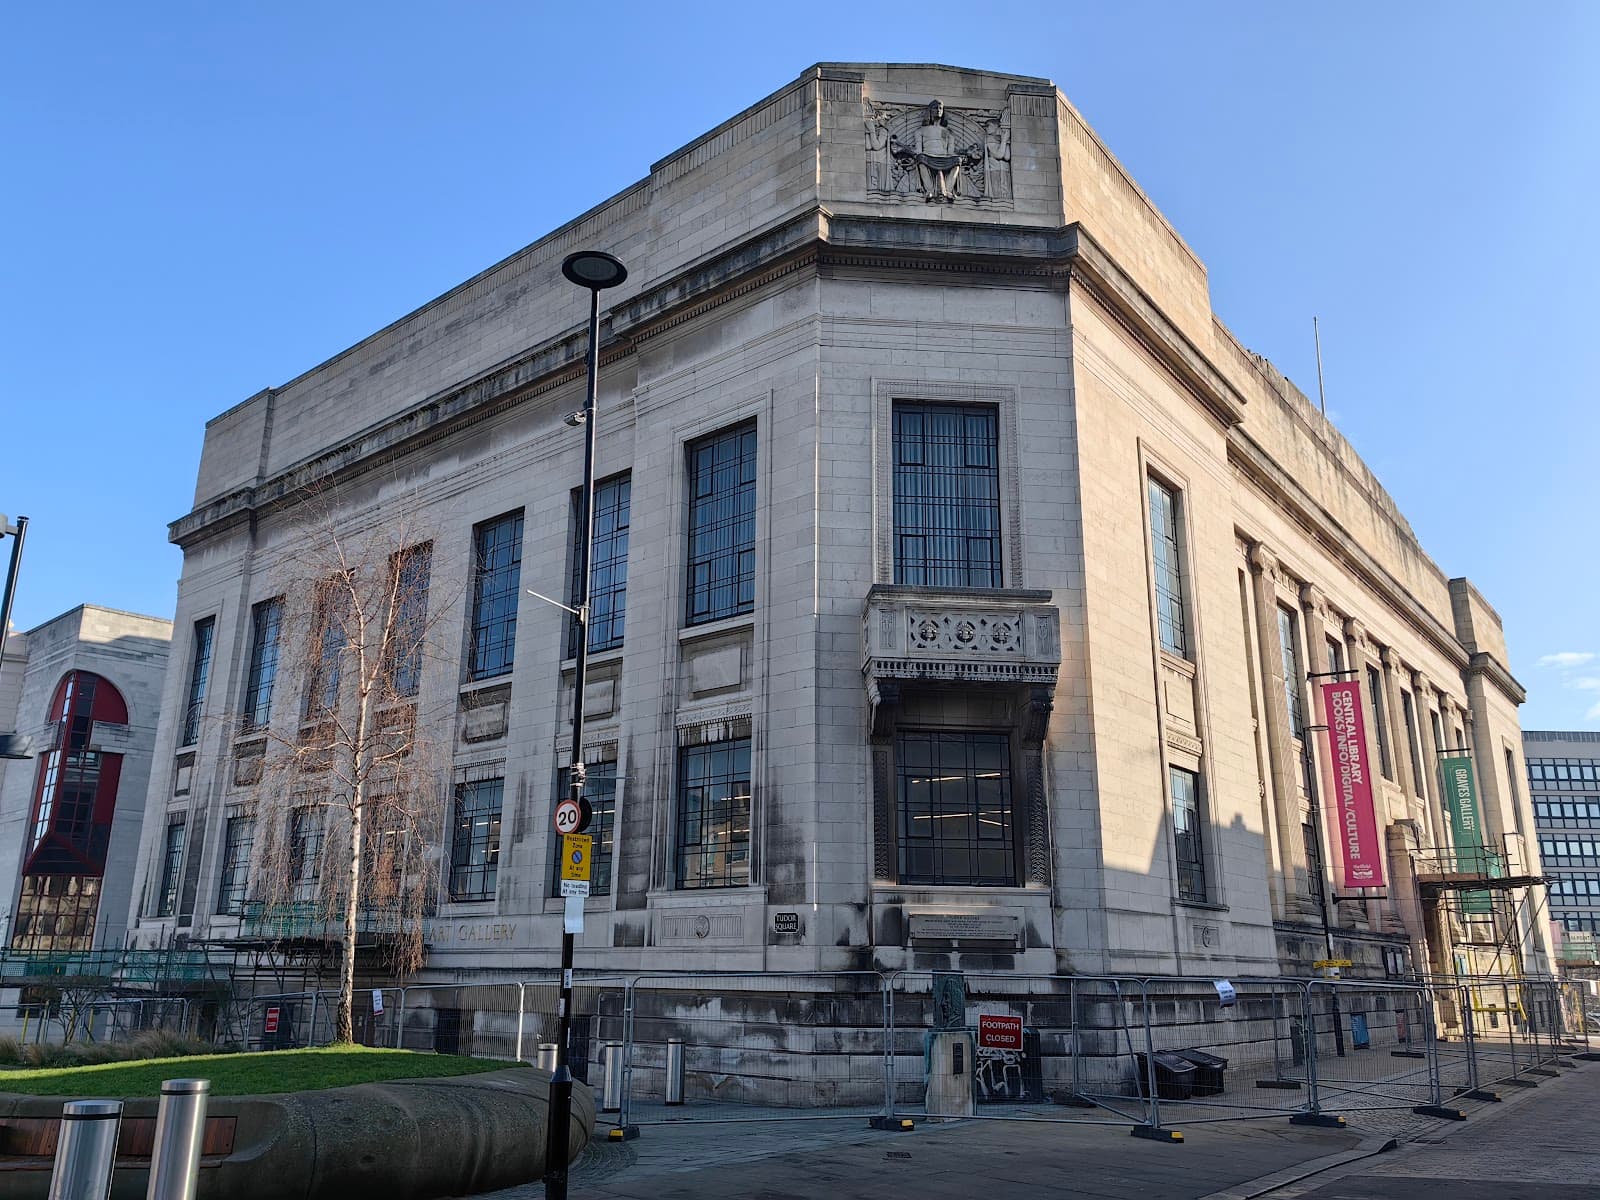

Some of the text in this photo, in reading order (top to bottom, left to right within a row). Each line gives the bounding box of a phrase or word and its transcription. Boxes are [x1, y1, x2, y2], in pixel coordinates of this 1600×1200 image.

[1342, 690, 1362, 785] CENTRAL LIBRARY
[1455, 768, 1475, 831] GRAVES GALLERY
[558, 809, 577, 826] 20
[429, 923, 517, 942] ART GALLERY
[776, 922, 797, 931] SQUARE
[982, 1021, 1019, 1030] FOOTPATH
[986, 1034, 1016, 1042] CLOSED
